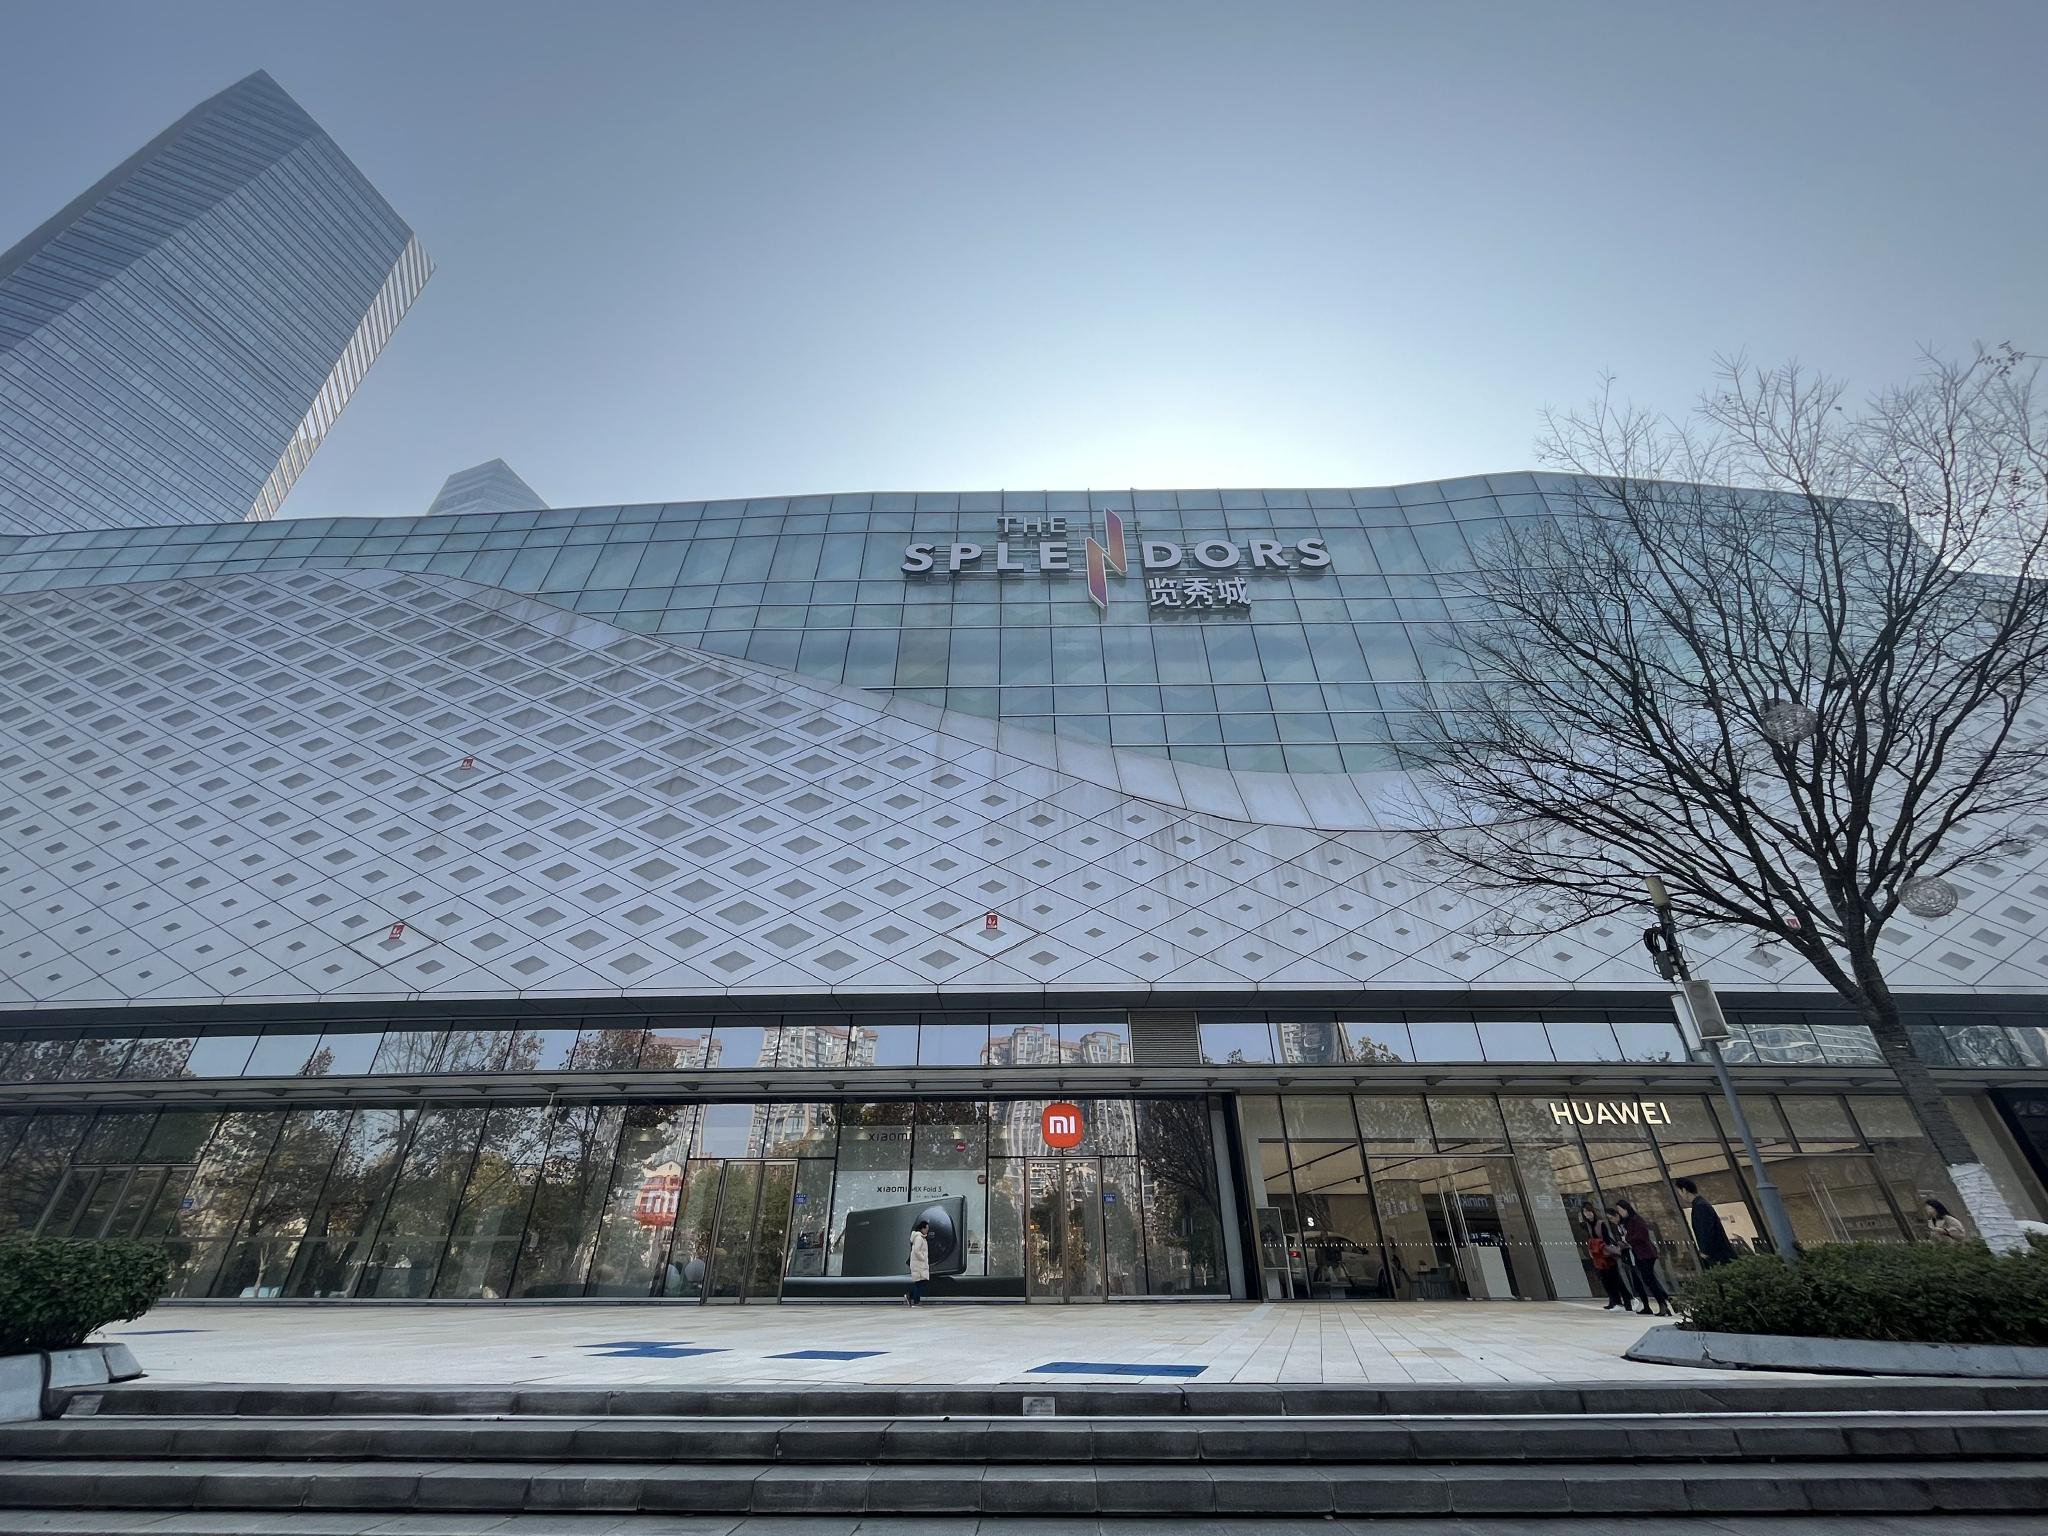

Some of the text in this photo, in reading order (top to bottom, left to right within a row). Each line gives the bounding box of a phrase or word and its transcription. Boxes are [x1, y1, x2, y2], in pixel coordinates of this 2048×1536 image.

[999, 516, 1067, 535] THE
[901, 507, 1332, 608] SPLENDORS
[1149, 576, 1252, 608] 览秀城
[1549, 1102, 1672, 1125] HUAWEI
